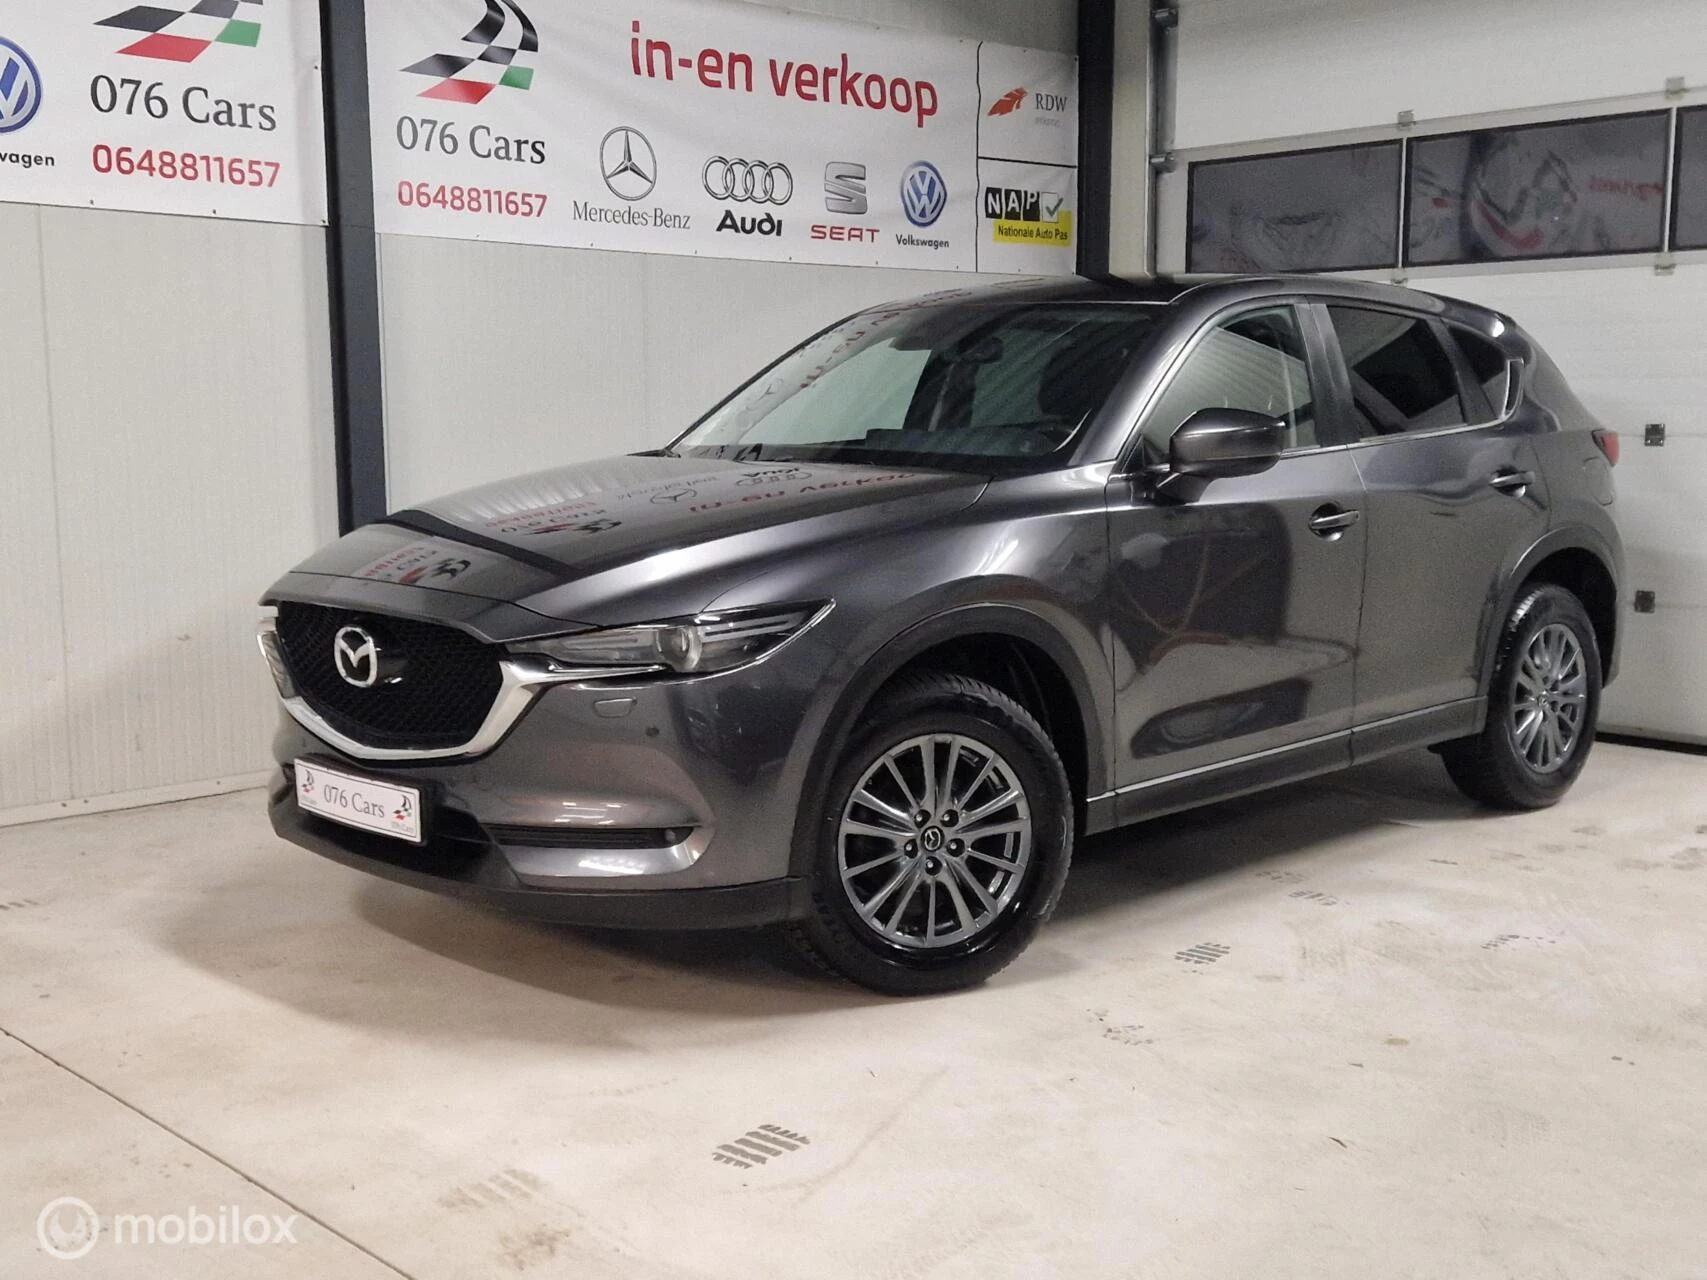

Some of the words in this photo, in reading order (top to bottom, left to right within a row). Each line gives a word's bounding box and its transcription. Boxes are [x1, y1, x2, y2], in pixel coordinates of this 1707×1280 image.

[631, 20, 753, 93] in-en
[769, 53, 939, 128] verkoop
[90, 75, 169, 119] 076
[182, 86, 277, 132] Cars
[1035, 92, 1068, 112] RDW
[397, 116, 459, 155] 076
[469, 125, 546, 165] Cars
[92, 144, 280, 188] 0648811657
[397, 181, 548, 218] 0648811657
[986, 188, 1038, 216] NAP
[573, 201, 691, 230] Mercedes-Benz
[715, 209, 782, 237] Audi
[810, 224, 880, 244] SEAT
[896, 234, 950, 250] Volkswagen
[998, 223, 1034, 238] Nationale
[1035, 227, 1053, 239] Auto
[1054, 230, 1068, 241] Pas
[324, 783, 348, 809] 076
[352, 792, 385, 818] Cars
